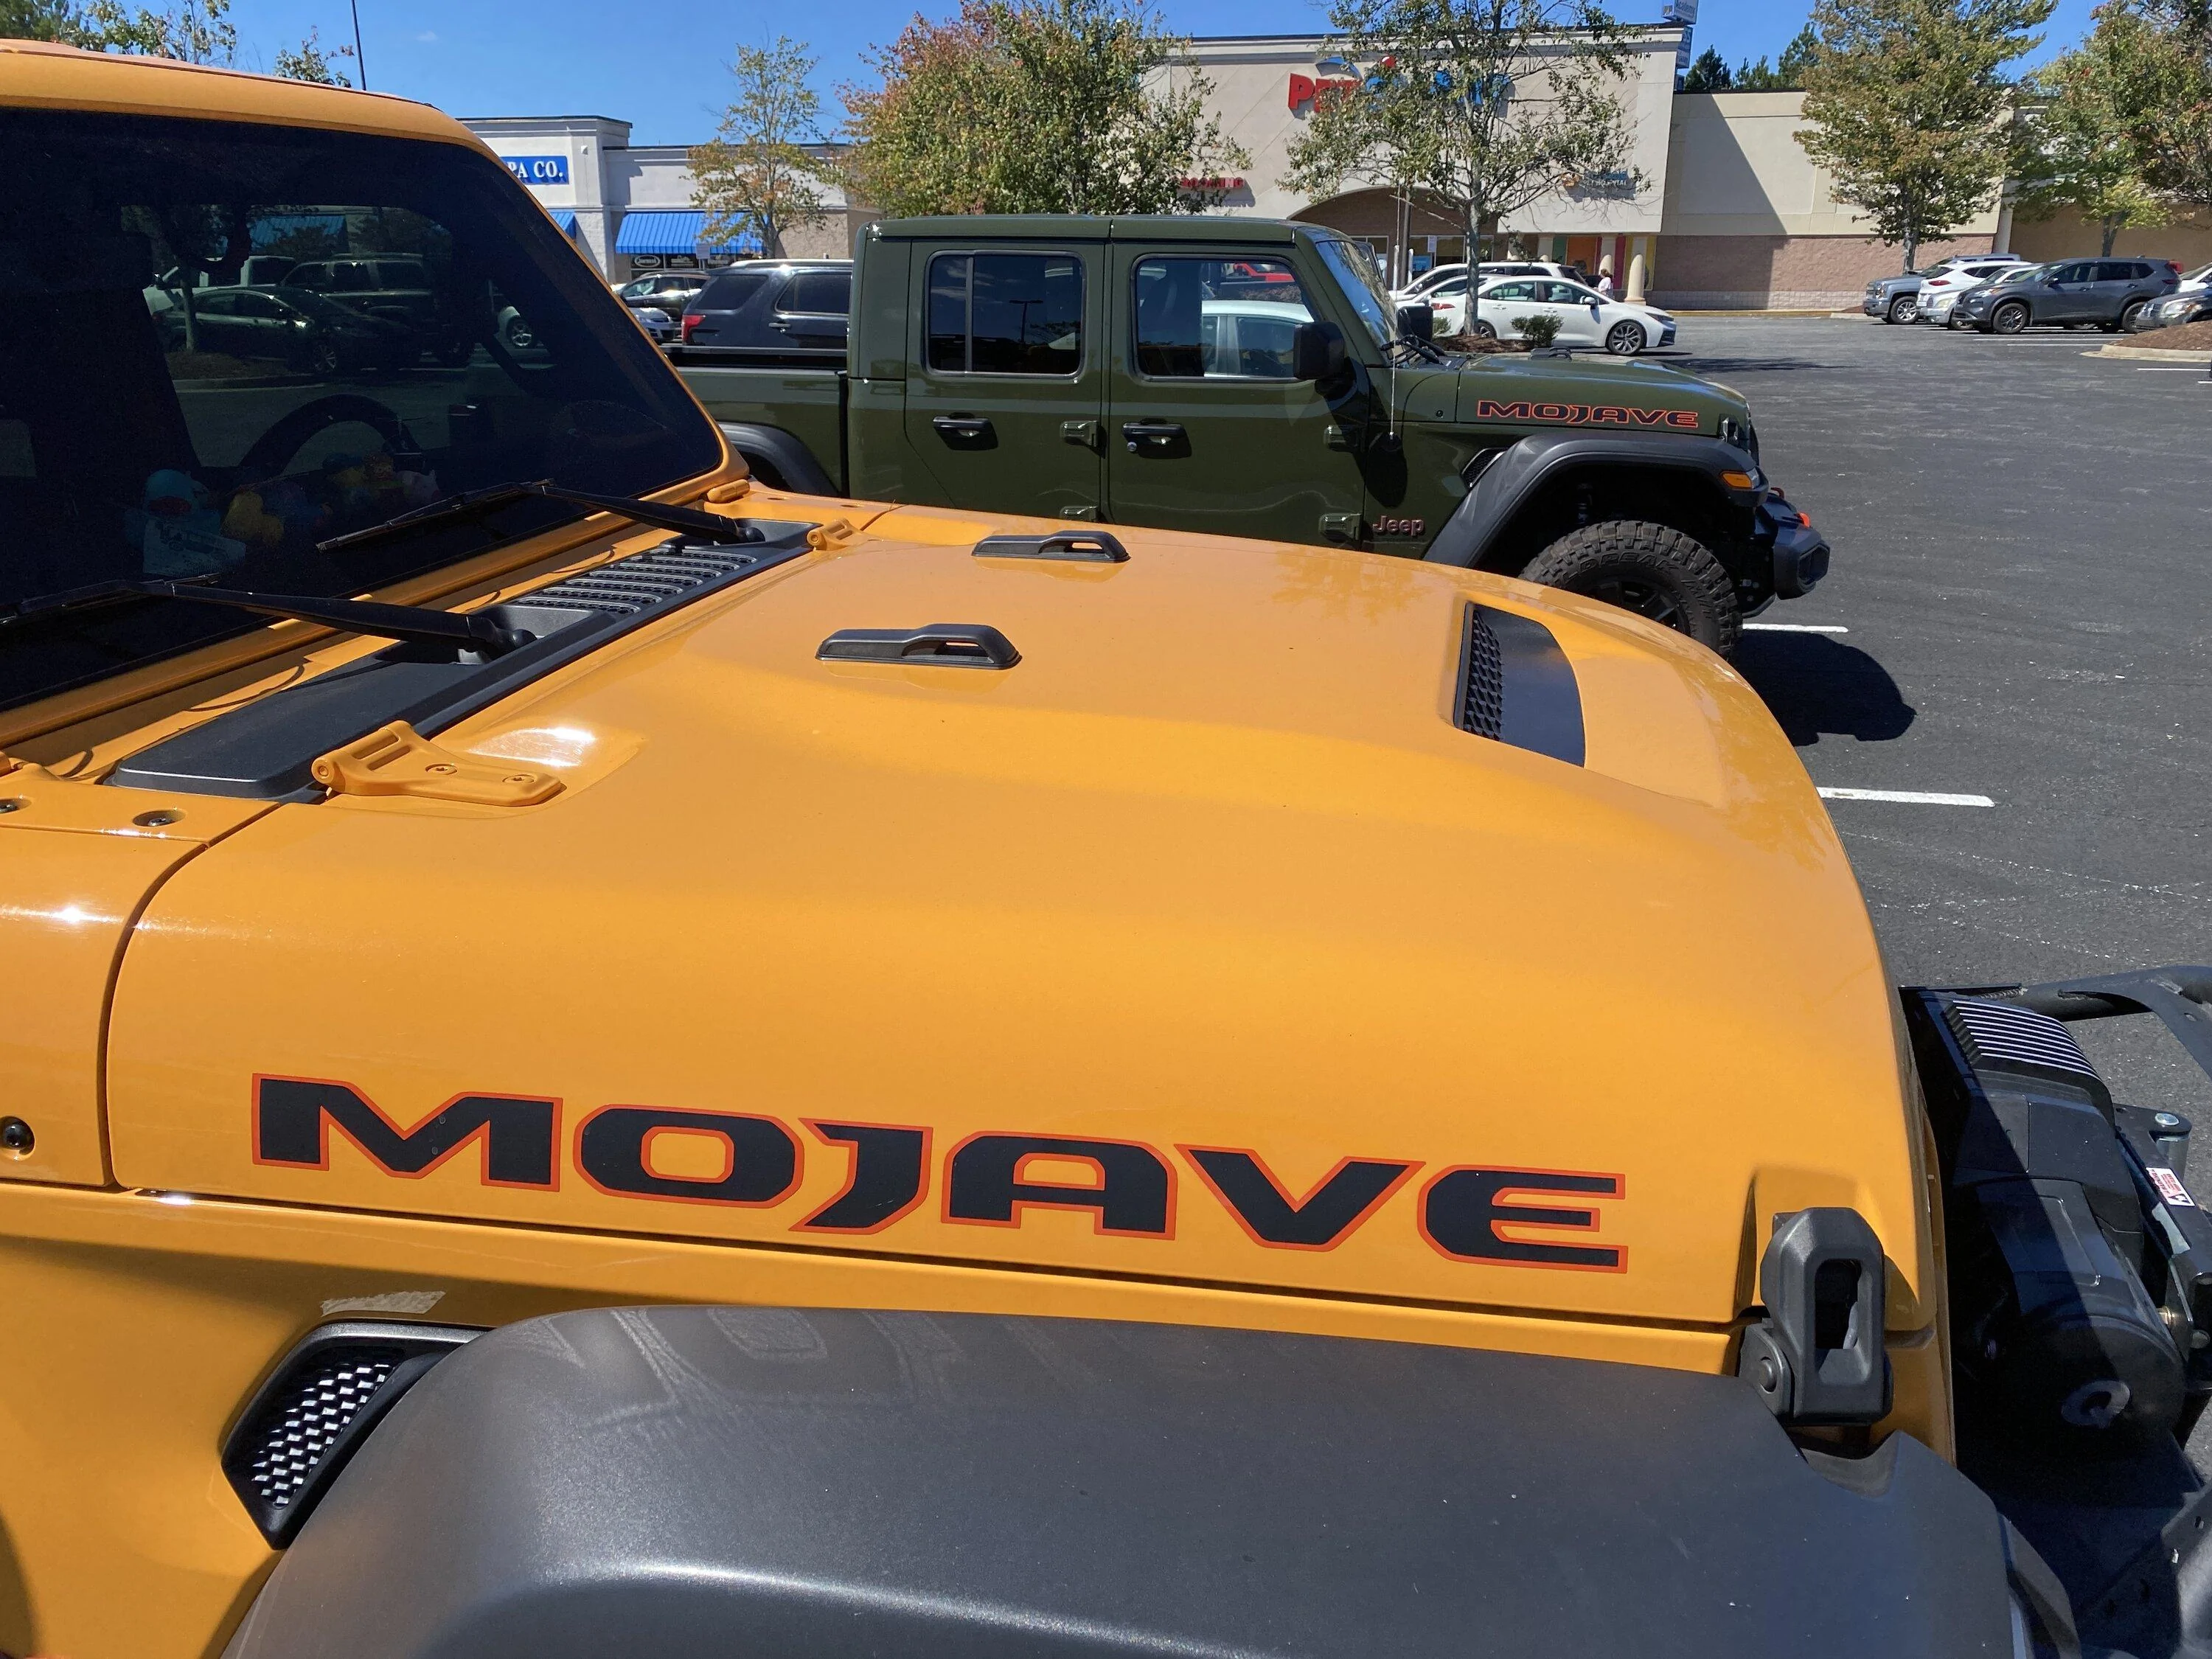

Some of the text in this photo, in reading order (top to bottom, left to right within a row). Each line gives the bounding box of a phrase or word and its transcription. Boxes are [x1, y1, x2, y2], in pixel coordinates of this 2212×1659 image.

[533, 160, 564, 178] CO.
[1478, 400, 1698, 428] MOJAVE
[1372, 515, 1424, 536] Jeep
[253, 1073, 1628, 1273] MOJAVE
